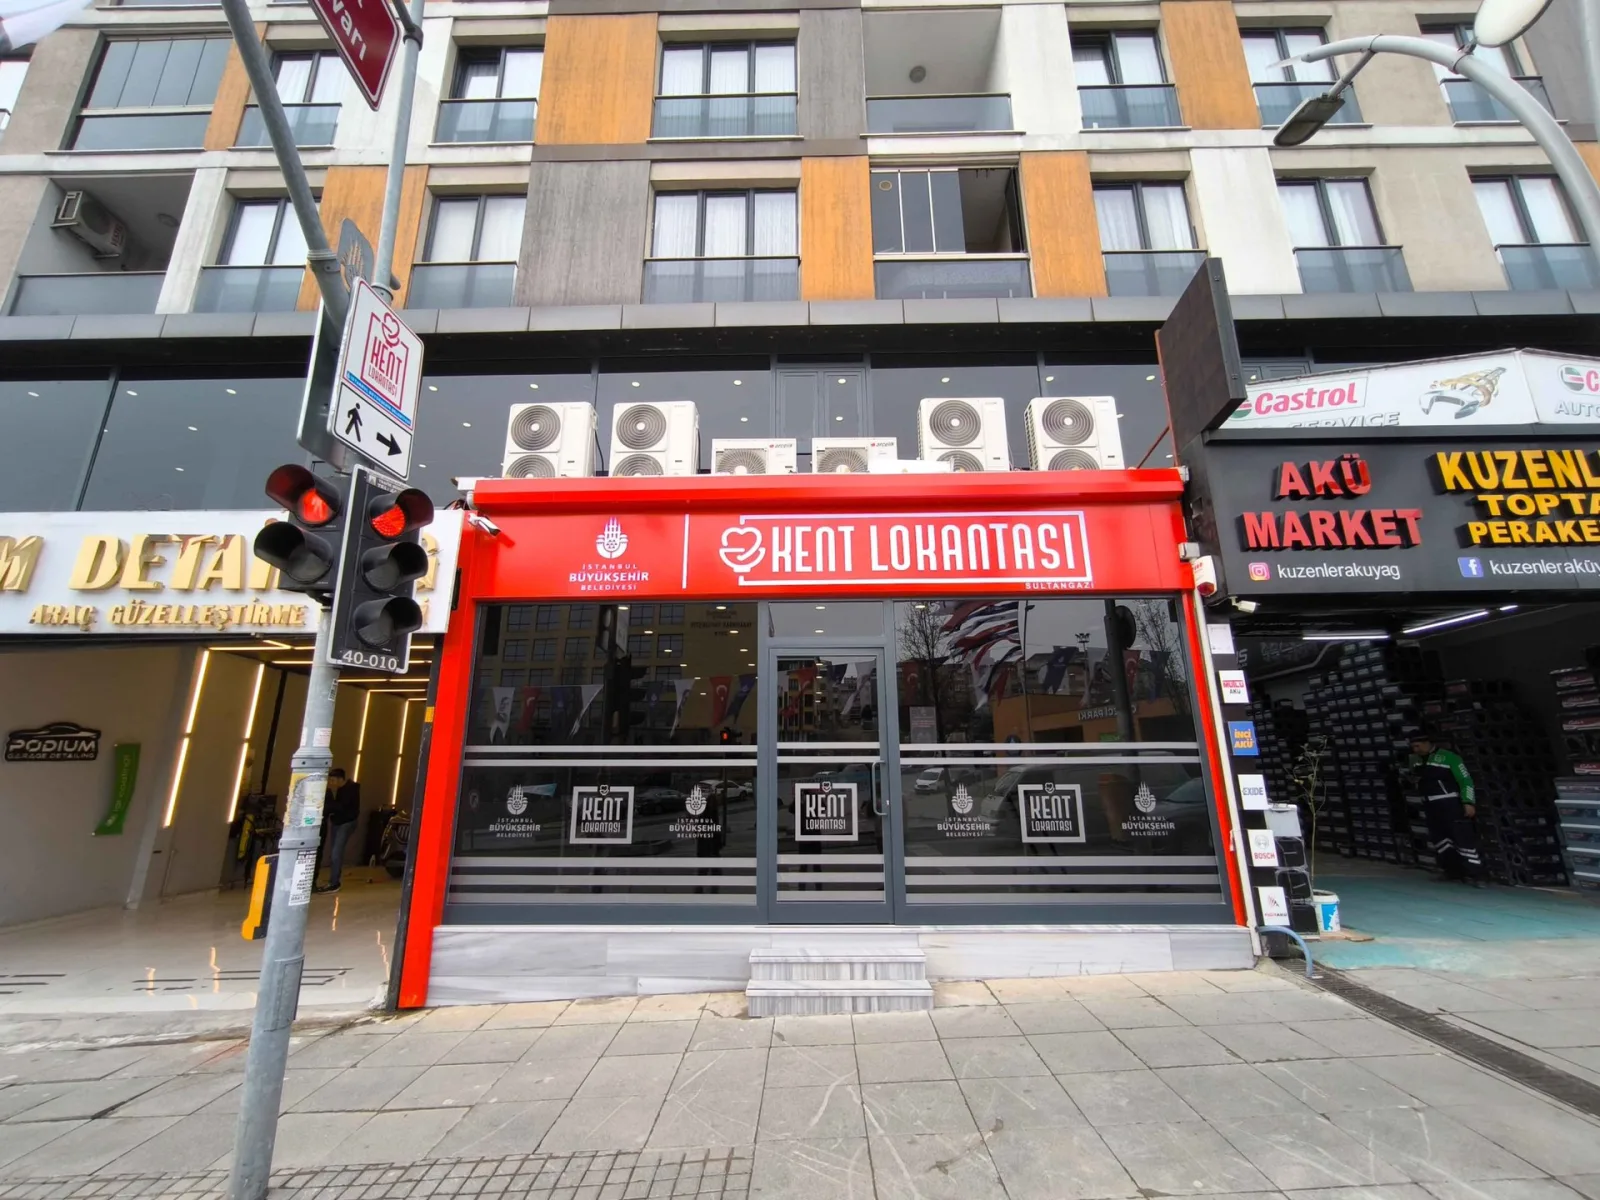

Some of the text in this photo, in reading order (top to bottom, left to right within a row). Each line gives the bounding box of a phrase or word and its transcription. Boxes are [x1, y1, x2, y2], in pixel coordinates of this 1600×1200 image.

[370, 336, 402, 385] KENT
[1255, 382, 1358, 415] Castrol
[1278, 453, 1372, 498] AKÜ
[1242, 508, 1423, 549] MARKET
[771, 522, 1076, 573] KENT LOKANTASI
[582, 562, 638, 570] İSTANBUL
[1277, 562, 1400, 580] kuzenlerakuyag
[569, 570, 649, 584] BÜYÜKŞEHİR
[580, 583, 637, 591] BELEDİYESİ
[28, 598, 309, 631] ARAÇ GÜZELLEŞTİRME
[342, 650, 397, 671] 40-010
[9, 739, 96, 752] PODIUM
[1242, 787, 1264, 796] EXIDE
[582, 797, 623, 821] KENT
[806, 794, 847, 818] KENT
[1029, 795, 1071, 819] KENT
[489, 823, 541, 832] BÜYÜKŞEHİR
[580, 822, 621, 833] LOKANTASI
[669, 823, 722, 832] BÜYÜKŞEHİR
[806, 819, 846, 830] LOKANTASI
[937, 822, 991, 831] BÜYÜKŞEHİR
[1031, 820, 1072, 832] LOKANTASI
[1121, 821, 1175, 830] BÜYÜKŞEHİR
[1253, 852, 1276, 860] BOSCH
